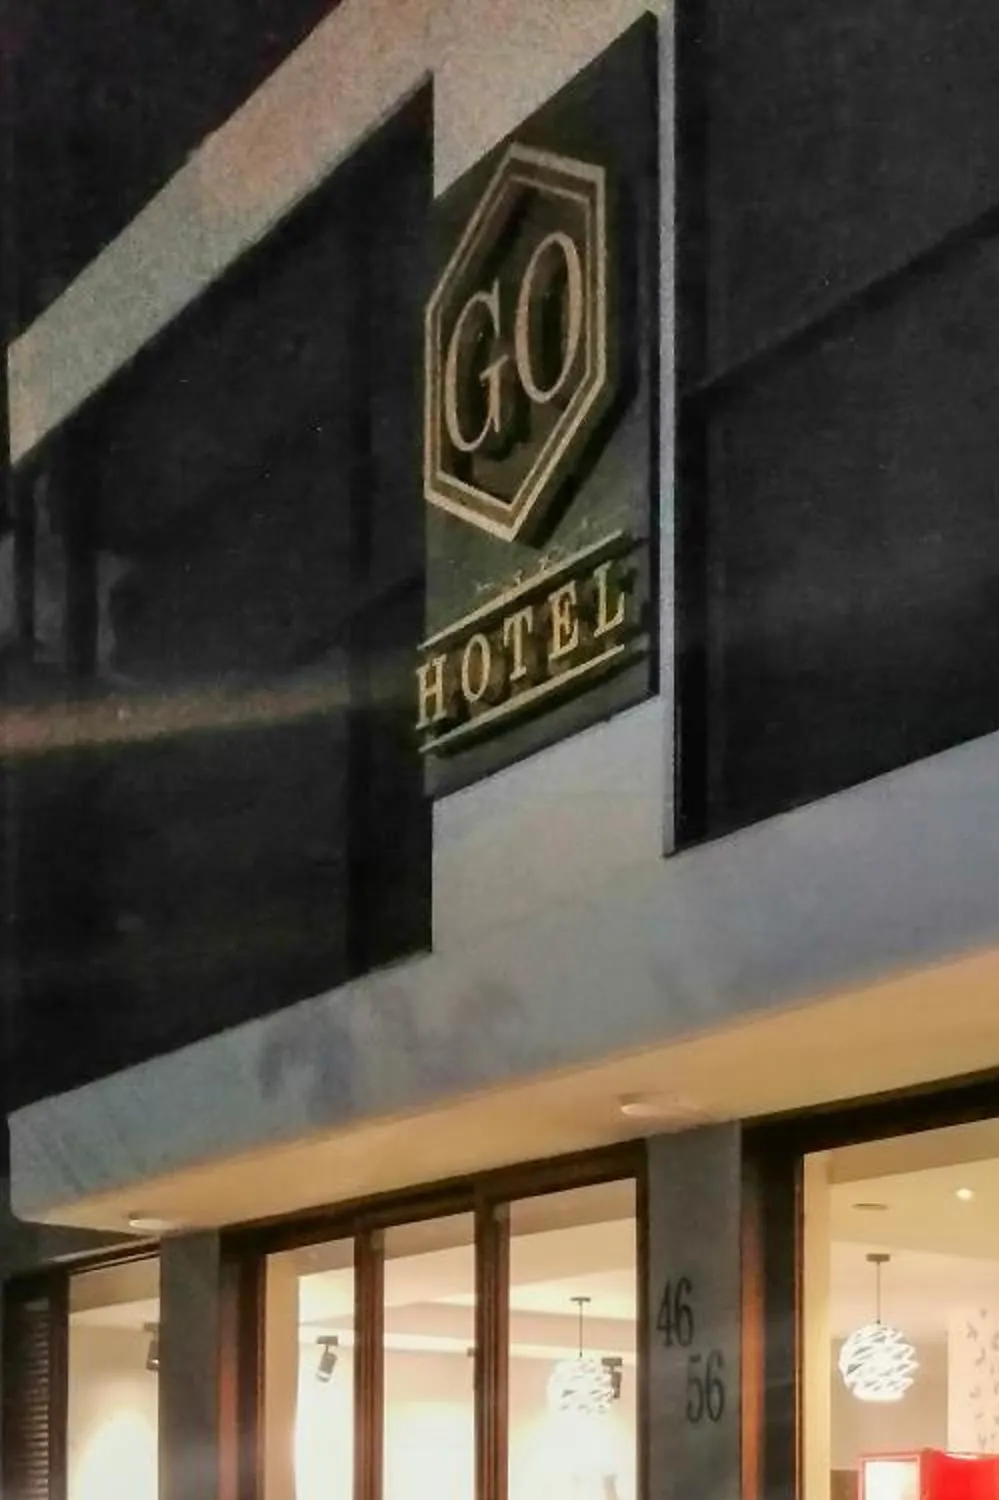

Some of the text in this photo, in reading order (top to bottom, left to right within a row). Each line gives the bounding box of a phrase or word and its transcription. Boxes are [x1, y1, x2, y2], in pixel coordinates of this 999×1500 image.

[444, 231, 584, 453] GO
[415, 560, 625, 731] HOTEL
[655, 1276, 694, 1348] 46
[685, 1350, 726, 1424] 56
